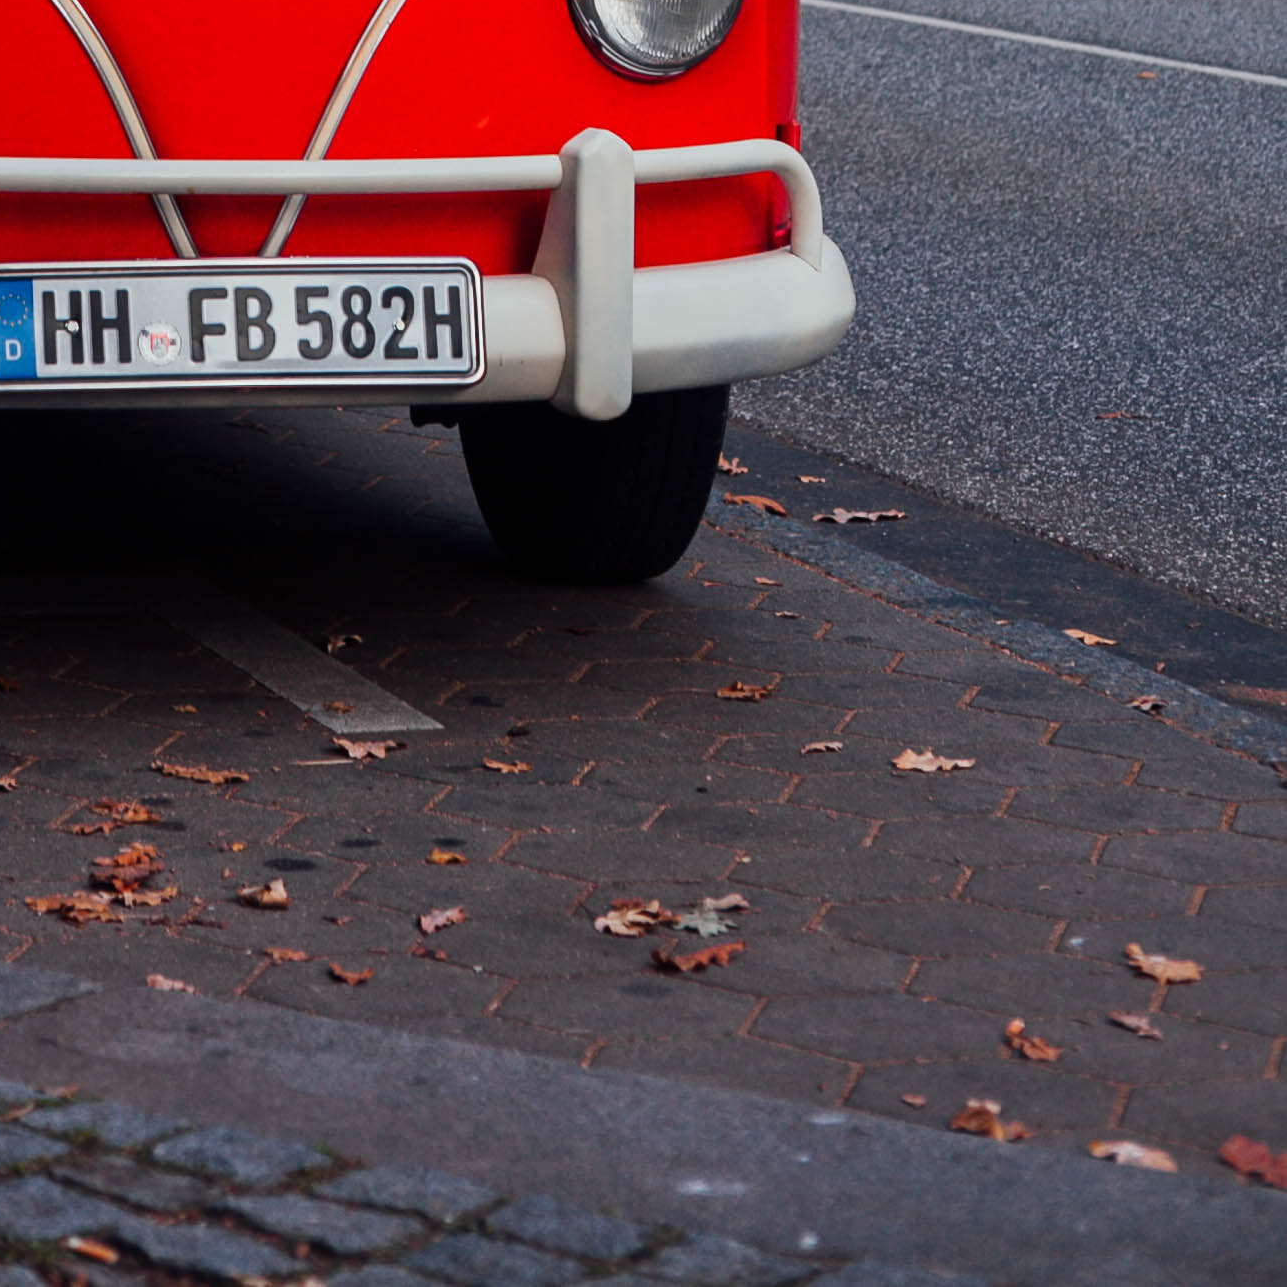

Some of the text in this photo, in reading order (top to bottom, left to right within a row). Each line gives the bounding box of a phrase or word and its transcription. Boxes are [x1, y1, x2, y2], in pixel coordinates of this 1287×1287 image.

[5, 284, 465, 365] D HH FB 582H
